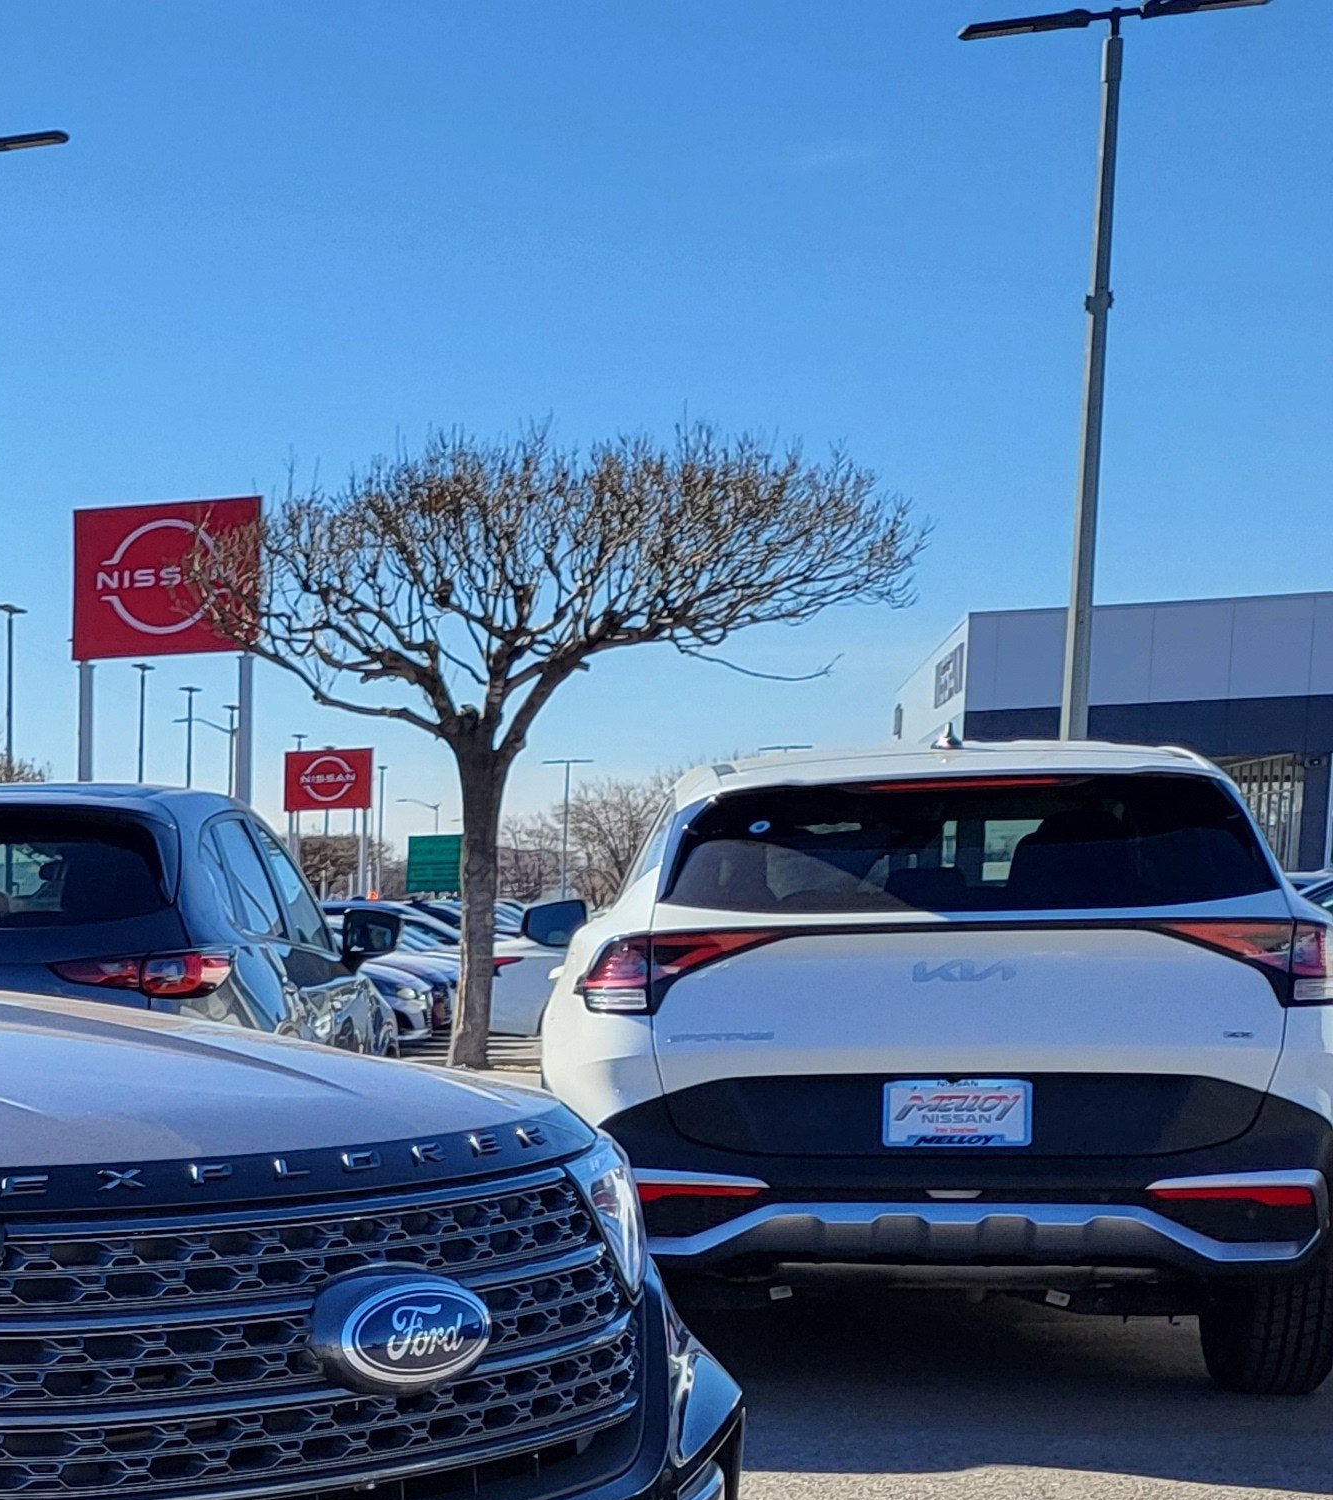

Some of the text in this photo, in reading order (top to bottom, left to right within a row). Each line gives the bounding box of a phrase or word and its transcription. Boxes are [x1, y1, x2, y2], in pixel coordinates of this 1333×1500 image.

[299, 773, 356, 785] NISSAN
[894, 1094, 1021, 1121] MELLOY
[921, 1113, 992, 1124] NISSAN
[914, 1135, 996, 1146] MELLOY
[0, 1127, 548, 1197] EXPLORER
[386, 1303, 465, 1361] Ford
